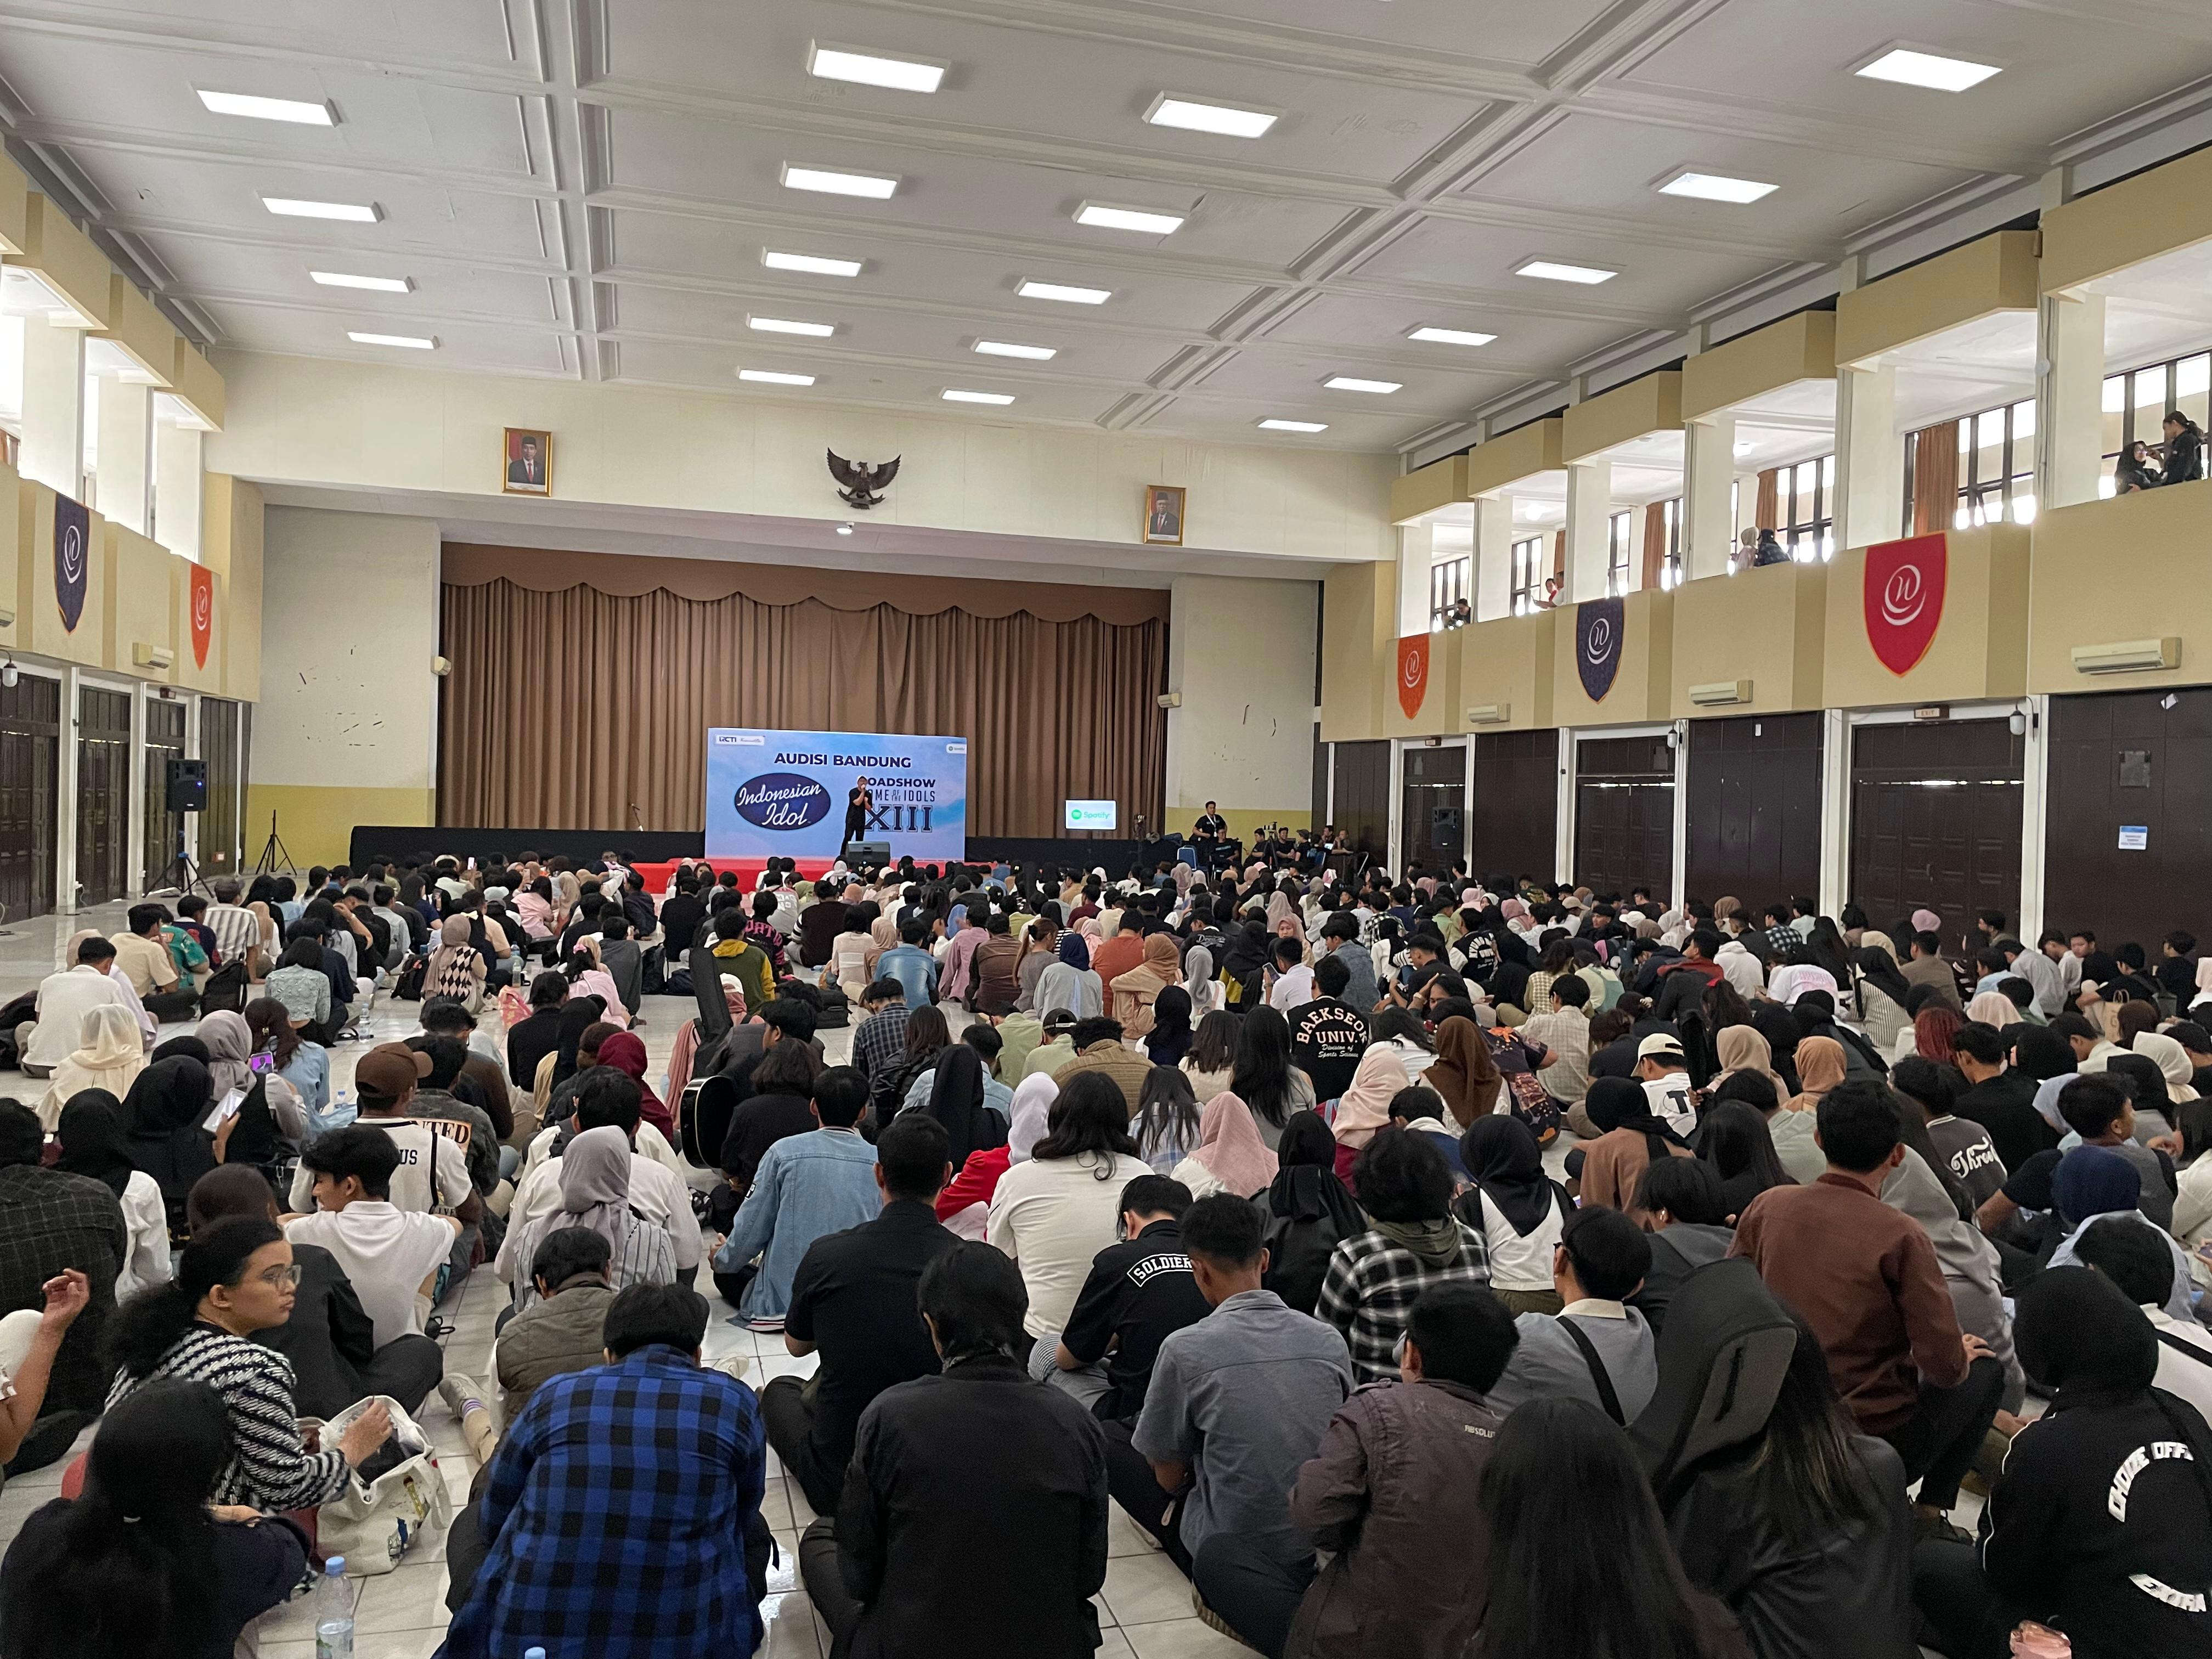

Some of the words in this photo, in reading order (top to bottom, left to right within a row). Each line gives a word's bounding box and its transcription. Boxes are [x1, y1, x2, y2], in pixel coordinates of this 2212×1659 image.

[774, 753, 827, 765] AUDISI
[833, 755, 911, 768] BANDUNG
[867, 777, 936, 788] OADSHOW
[737, 783, 822, 806] Indonesian
[904, 790, 935, 802] IDOLS
[761, 803, 808, 826] Idol
[864, 804, 933, 832] XIII
[1296, 1007, 1367, 1044] BAEKSEOK
[1316, 1031, 1358, 1043] UNIV.
[1133, 1256, 1193, 1279] SOLDIER
